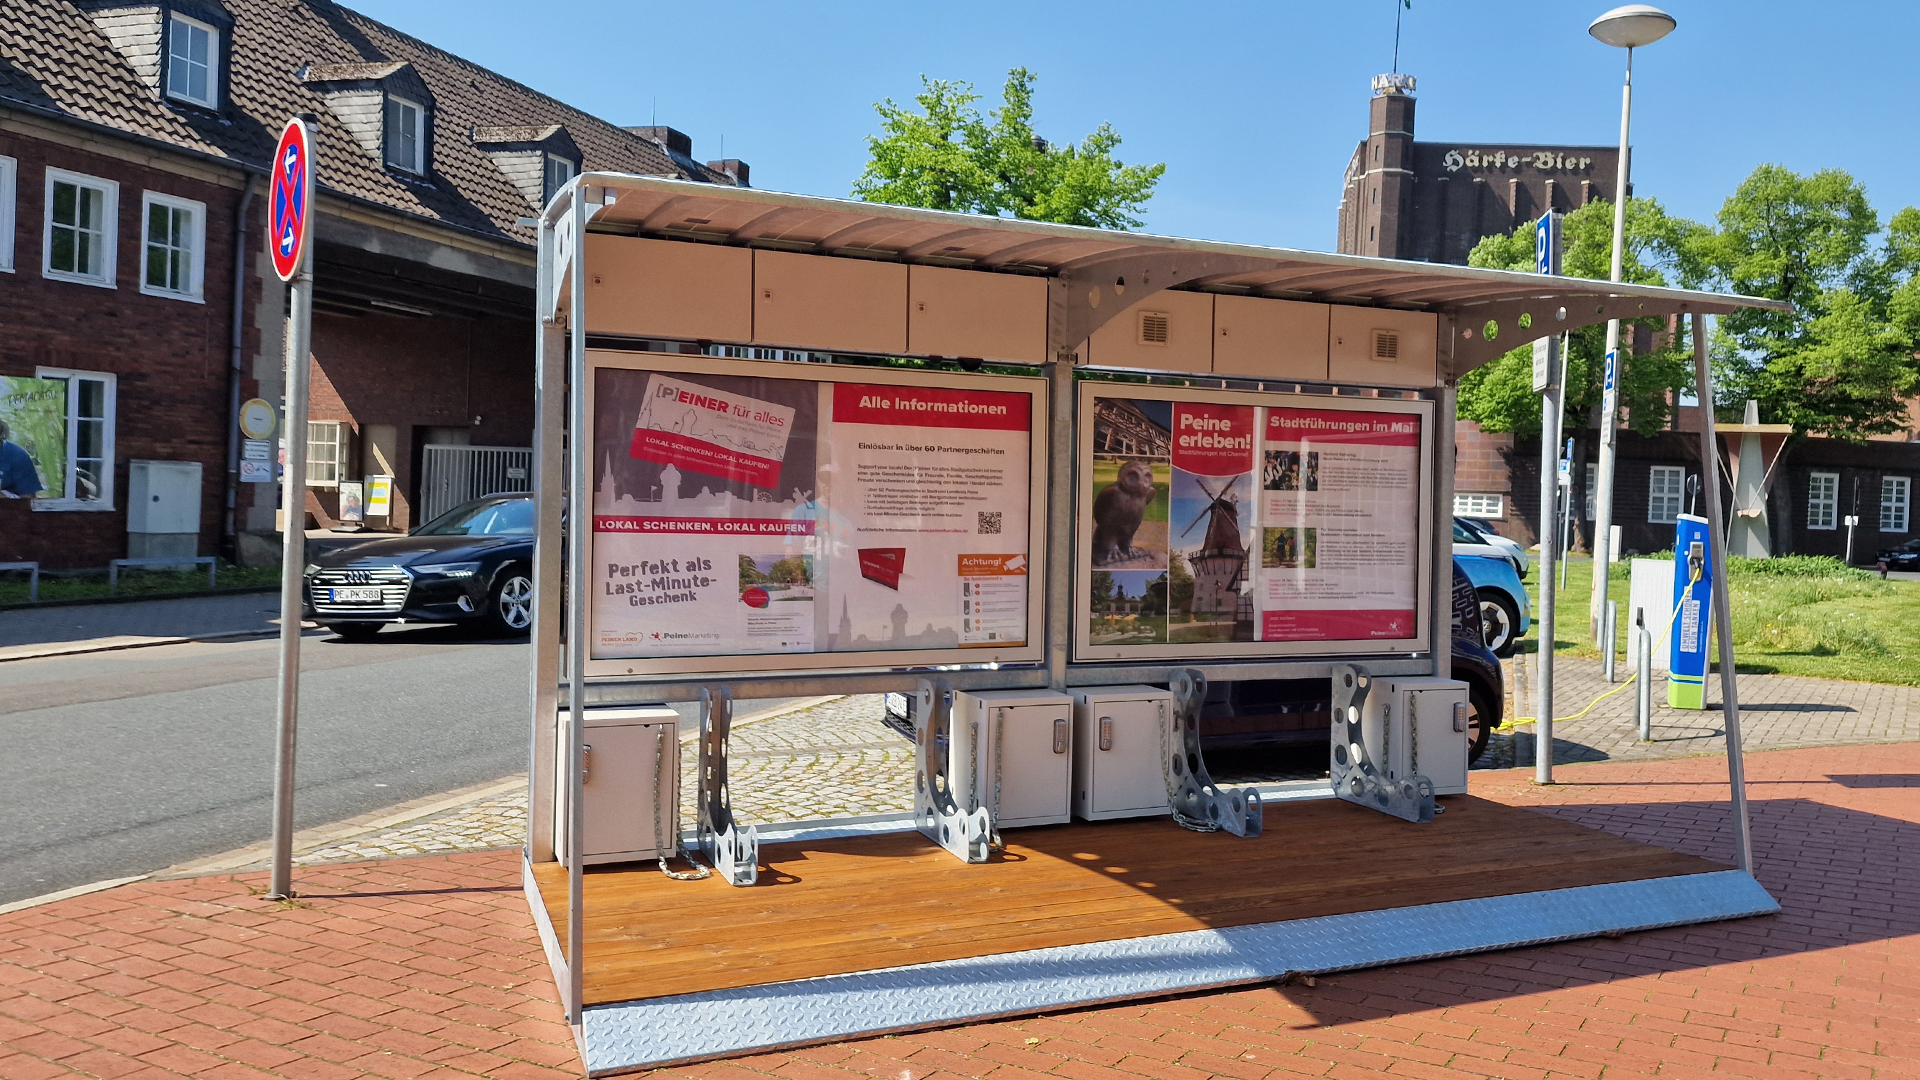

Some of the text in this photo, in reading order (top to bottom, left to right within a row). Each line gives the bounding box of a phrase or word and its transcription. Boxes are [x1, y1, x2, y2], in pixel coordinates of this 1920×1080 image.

[1443, 149, 1592, 172] Härke-Bier
[656, 384, 785, 427] [P]EINER für alles
[859, 395, 1007, 415] Alle Informationen
[1180, 413, 1231, 432] Peine
[1270, 416, 1413, 433] Stadtführungen im Mai
[858, 442, 894, 451] Einlösbar
[904, 444, 922, 452] über
[937, 446, 1005, 455] Partnergeschäften
[1179, 433, 1251, 450] erleben!
[646, 436, 770, 470] LOKAL SCHENKEN! LOKAL KAUFEN!
[599, 520, 640, 530] LOKAL
[642, 521, 714, 532] SCHENKEN,
[718, 522, 756, 532] LOKAL
[760, 523, 806, 533] KAUFEN
[608, 556, 712, 578] Perfekt als
[962, 558, 1002, 566] Achtung!
[335, 590, 380, 599] PE PK 588
[605, 576, 717, 596] Last-Minute-
[629, 590, 698, 607] Geschenk
[1682, 622, 1690, 649] UMWELT
